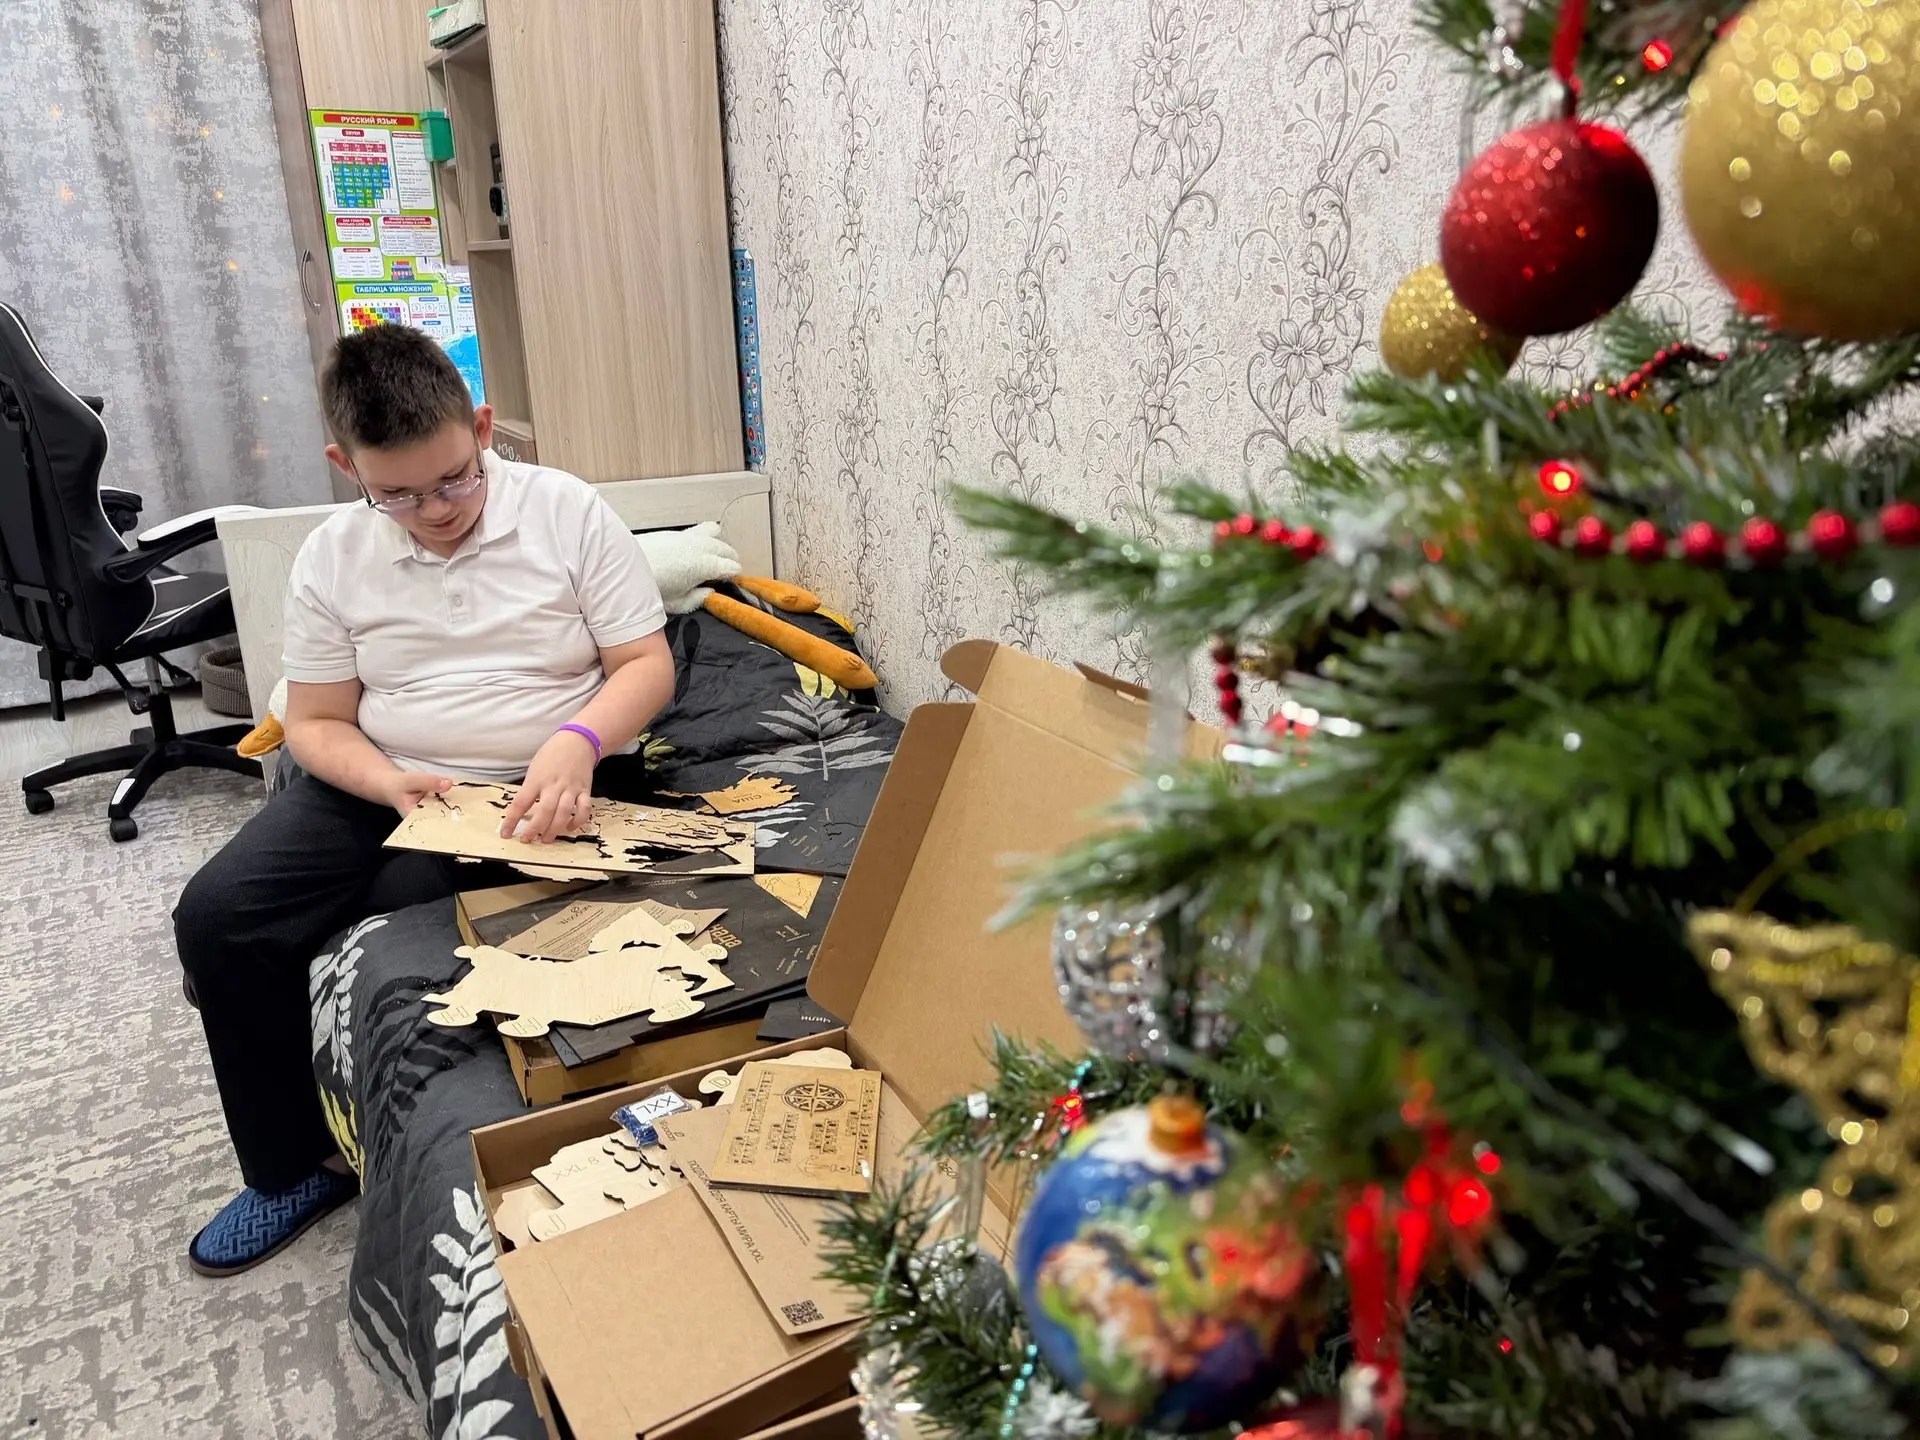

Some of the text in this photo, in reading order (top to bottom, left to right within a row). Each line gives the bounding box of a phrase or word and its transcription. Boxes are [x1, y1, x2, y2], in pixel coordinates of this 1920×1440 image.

[340, 116, 398, 125] РУССКИЙ ЯЗЫК
[731, 794, 762, 804] США
[709, 923, 743, 949] нада
[636, 1095, 678, 1114] XXL
[552, 1156, 599, 1181] XXL 8
[688, 1160, 712, 1190] ПОДЛОЖ
[720, 1202, 741, 1228] КАРТЫ
[736, 1225, 755, 1250] МИРА
[749, 1247, 765, 1264] XXL
